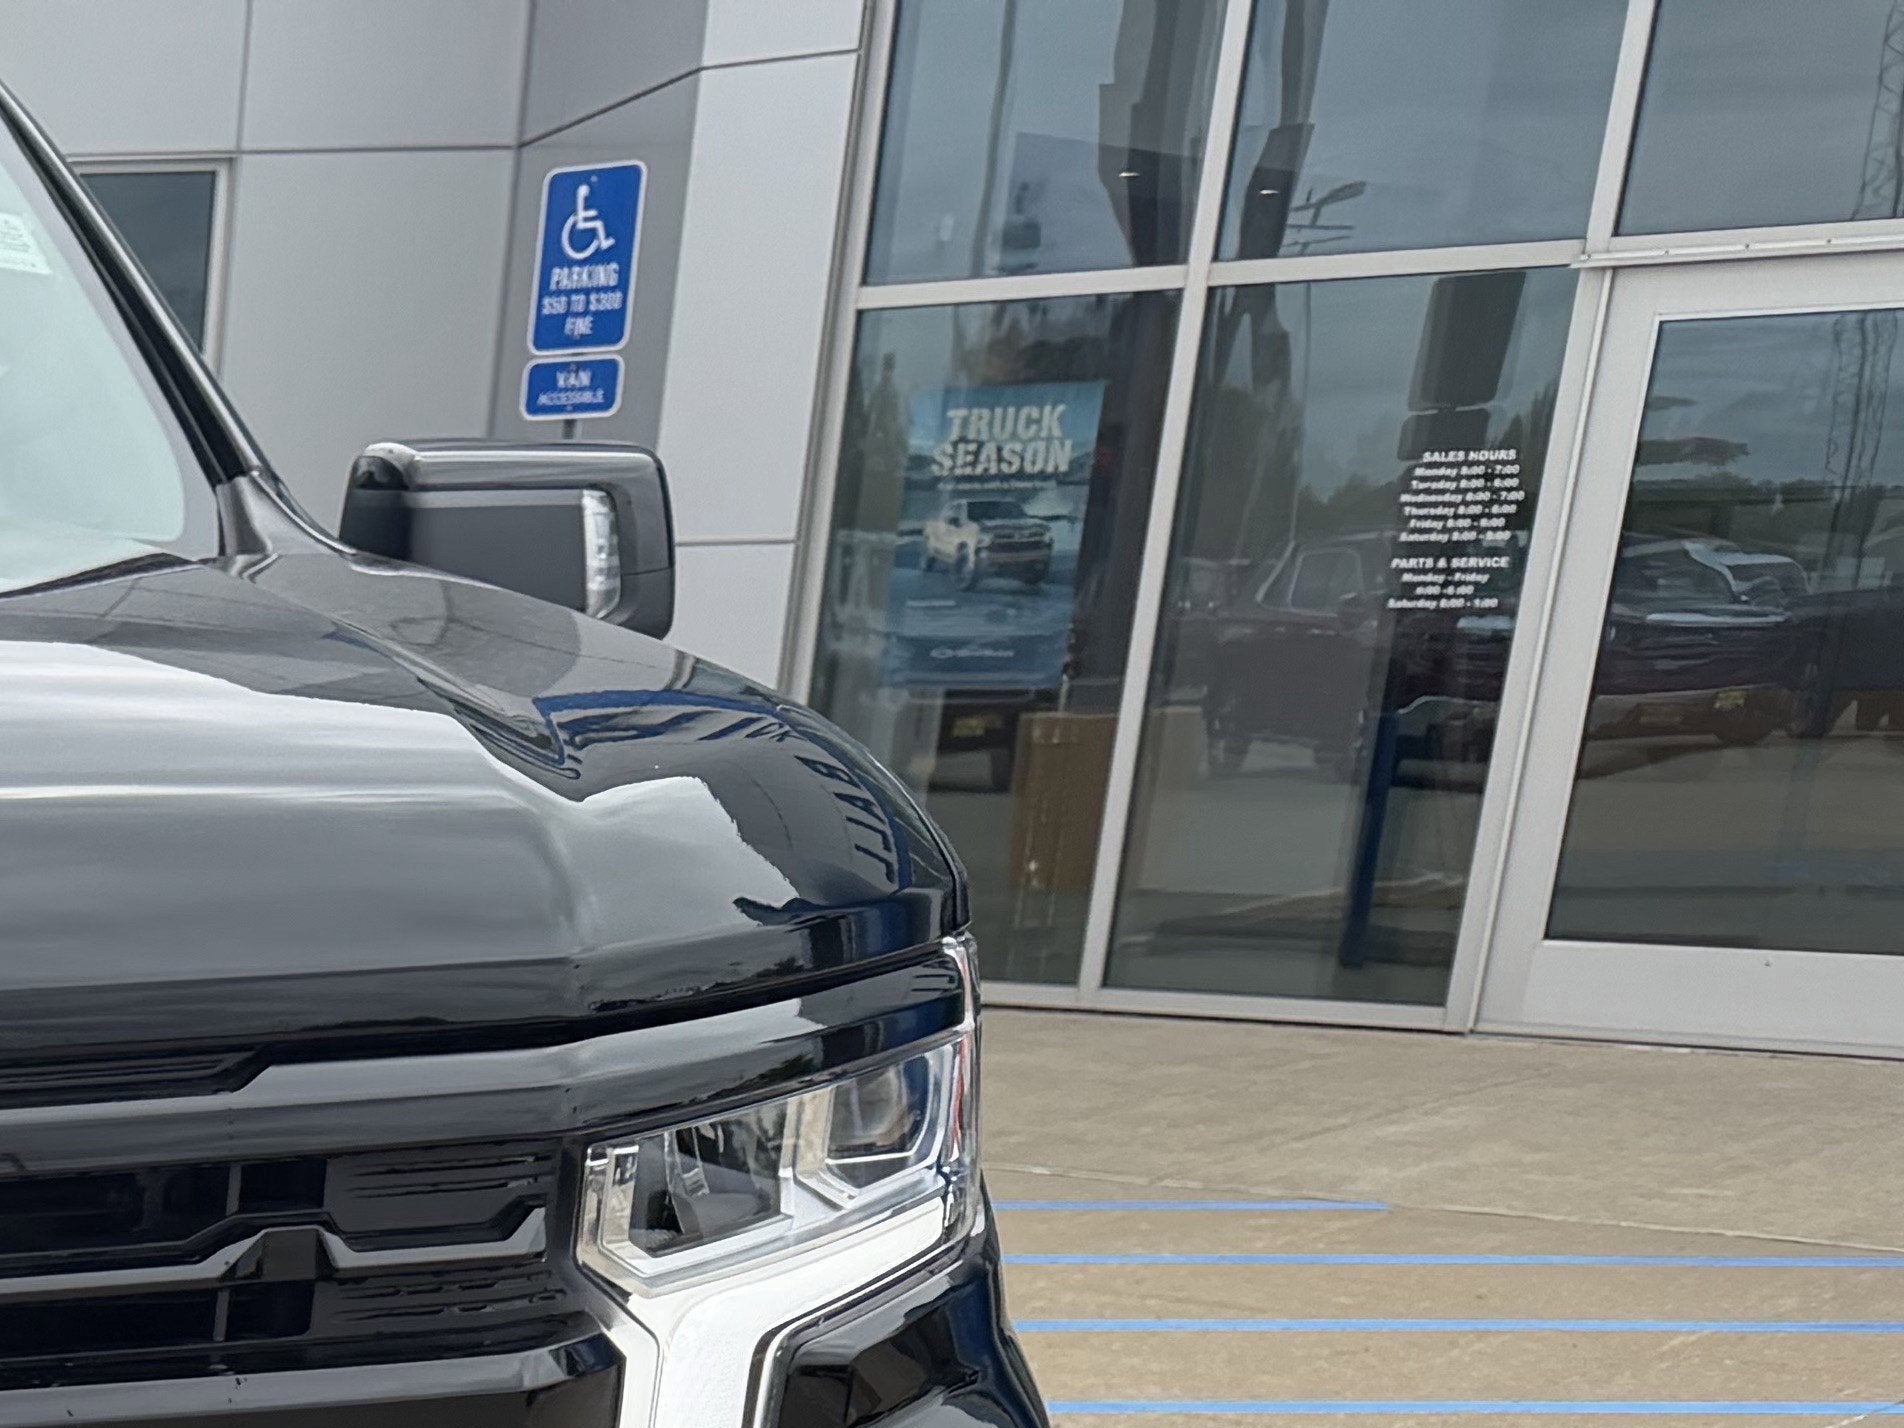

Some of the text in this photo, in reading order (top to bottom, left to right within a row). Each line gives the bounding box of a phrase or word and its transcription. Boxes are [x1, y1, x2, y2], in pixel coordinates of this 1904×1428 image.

[549, 263, 619, 291] PARKING
[542, 296, 568, 315] $50
[570, 294, 586, 313] TO
[564, 315, 593, 336] FINE
[556, 369, 592, 387] VAN
[537, 388, 604, 405] ACCESSIBLE
[946, 402, 1067, 443] TRUCK
[931, 438, 1073, 478] SEASON
[1422, 449, 1516, 462] SALES HOURS
[1414, 467, 1458, 477] Monday
[1495, 464, 1520, 474] 7:00
[1411, 480, 1457, 490] Tuesday
[1400, 493, 1463, 503] Wednesday
[1404, 506, 1455, 516] Thursday
[1409, 519, 1444, 530] Friday
[1399, 532, 1449, 543] Saturday
[1391, 557, 1510, 569] PARTS & SERVICE
[1401, 573, 1446, 584] Monday
[1455, 573, 1490, 583] Friday
[1387, 598, 1437, 610] Saturday
